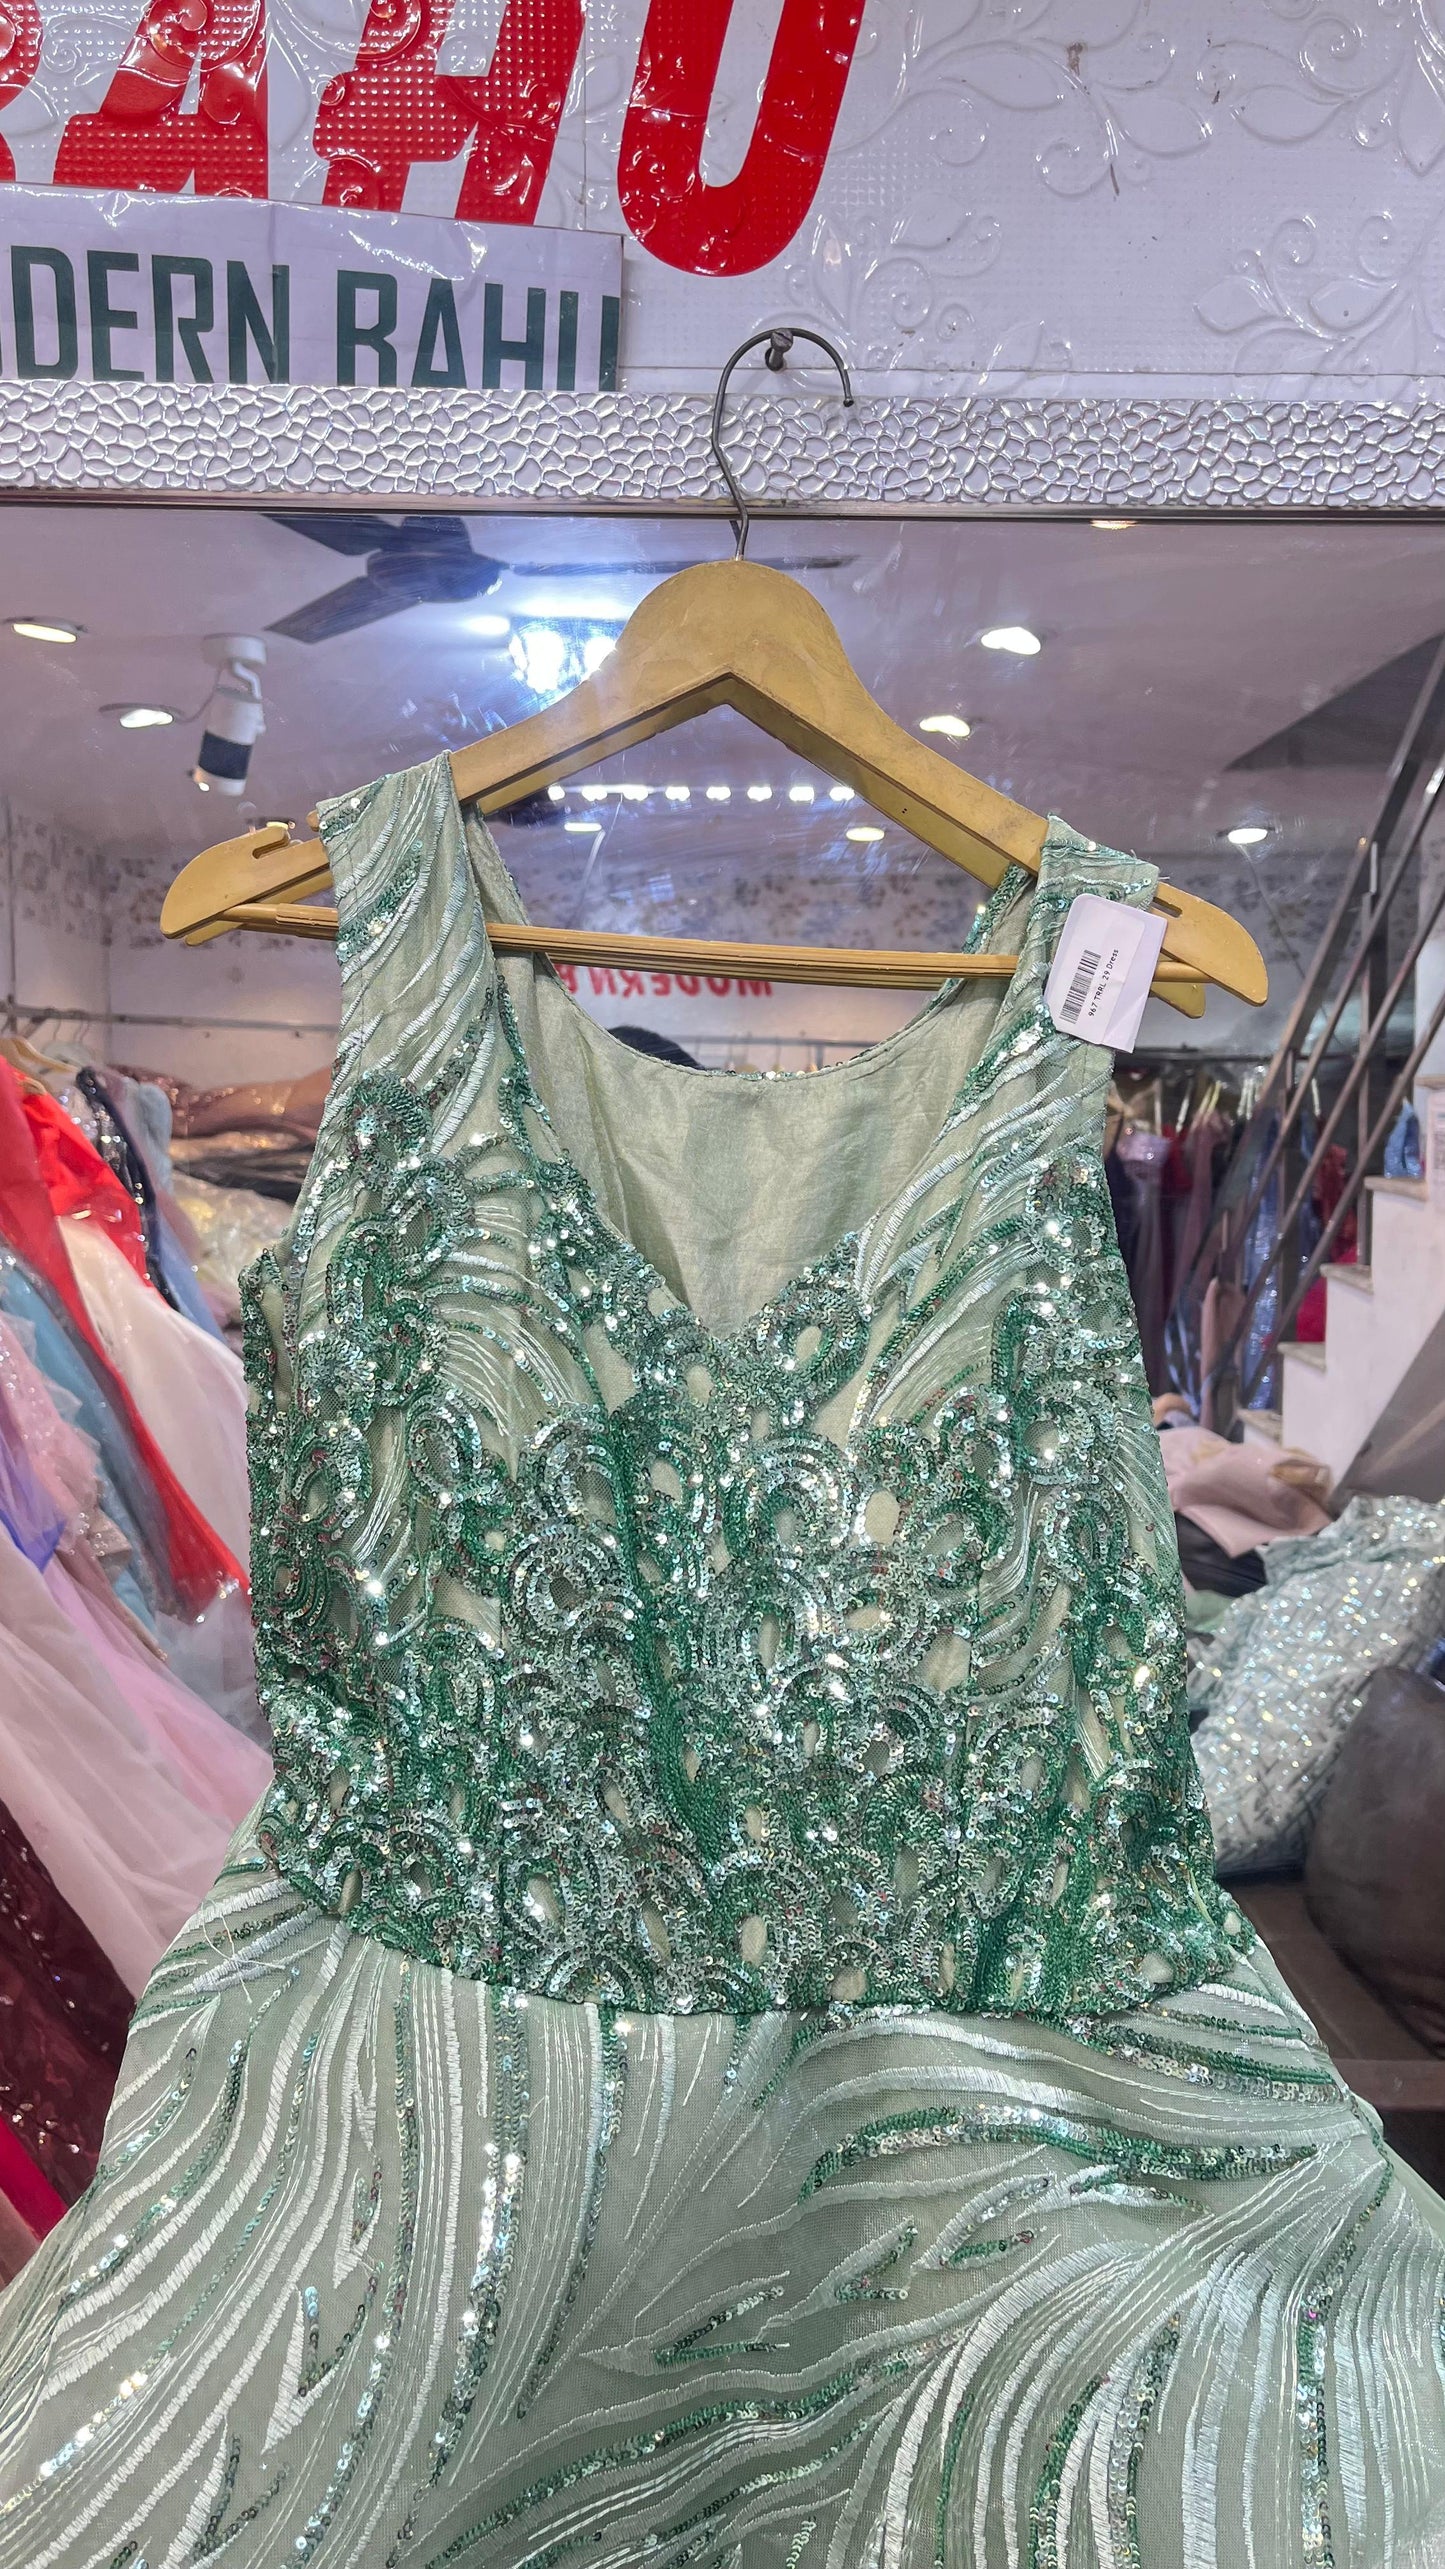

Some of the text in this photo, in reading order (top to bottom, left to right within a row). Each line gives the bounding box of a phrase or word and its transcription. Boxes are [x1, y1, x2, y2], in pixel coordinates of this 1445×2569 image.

[0, 245, 290, 386] DERN
[1106, 949, 1119, 970] Dress
[1102, 970, 1111, 981] 29
[1088, 1002, 1098, 1017] 967
